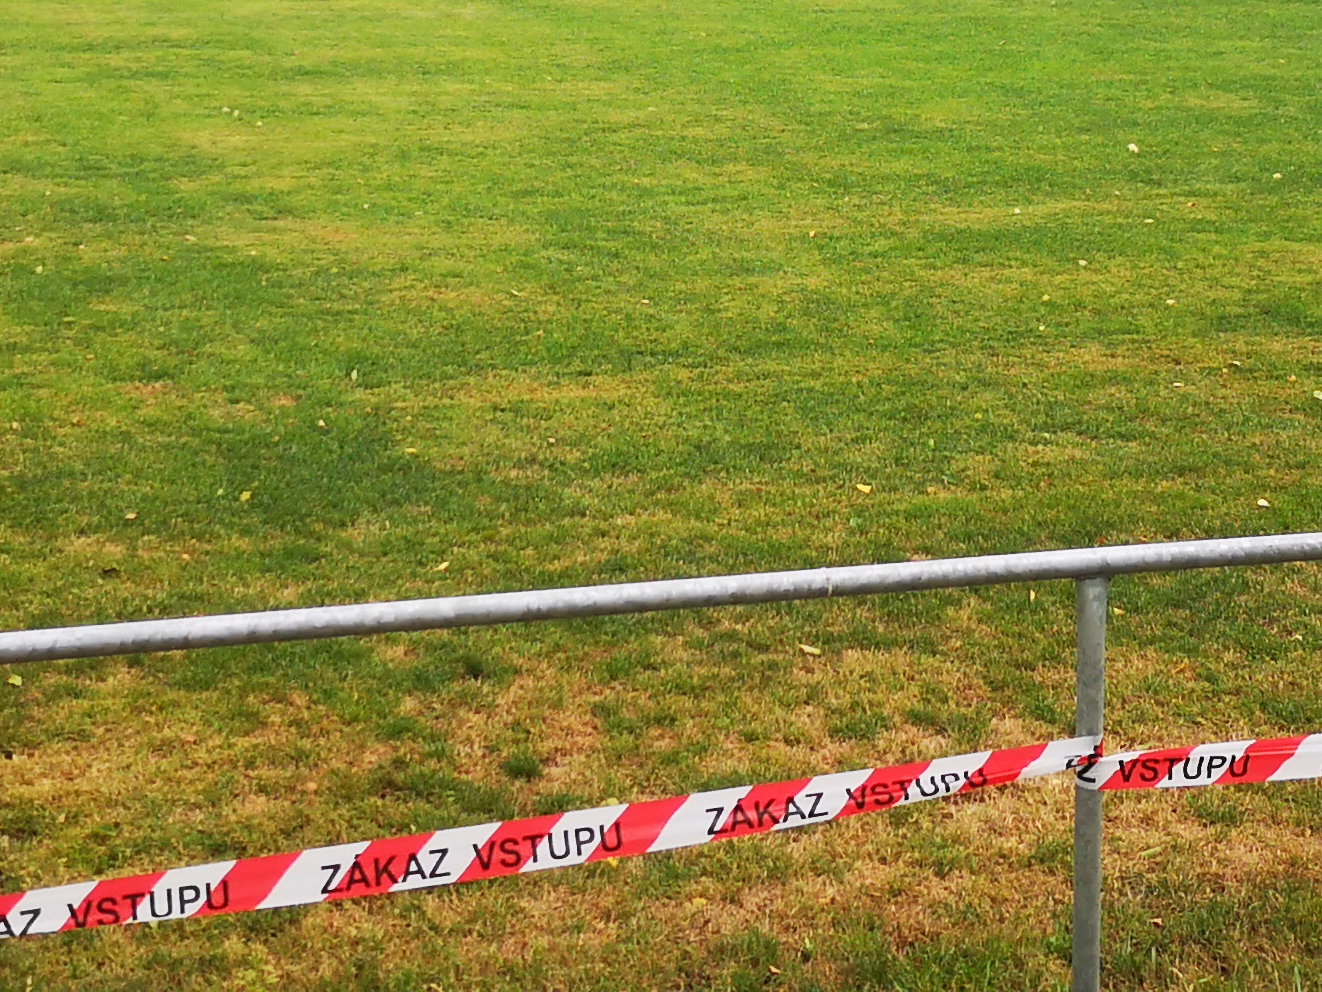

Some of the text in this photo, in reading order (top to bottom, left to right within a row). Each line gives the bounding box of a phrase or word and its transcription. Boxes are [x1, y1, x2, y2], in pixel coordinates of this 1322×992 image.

[846, 768, 988, 810] VSTUPU
[1118, 755, 1250, 782] VSTUPU
[472, 821, 623, 872] VSTUPU
[67, 880, 230, 928] VSTUPU
